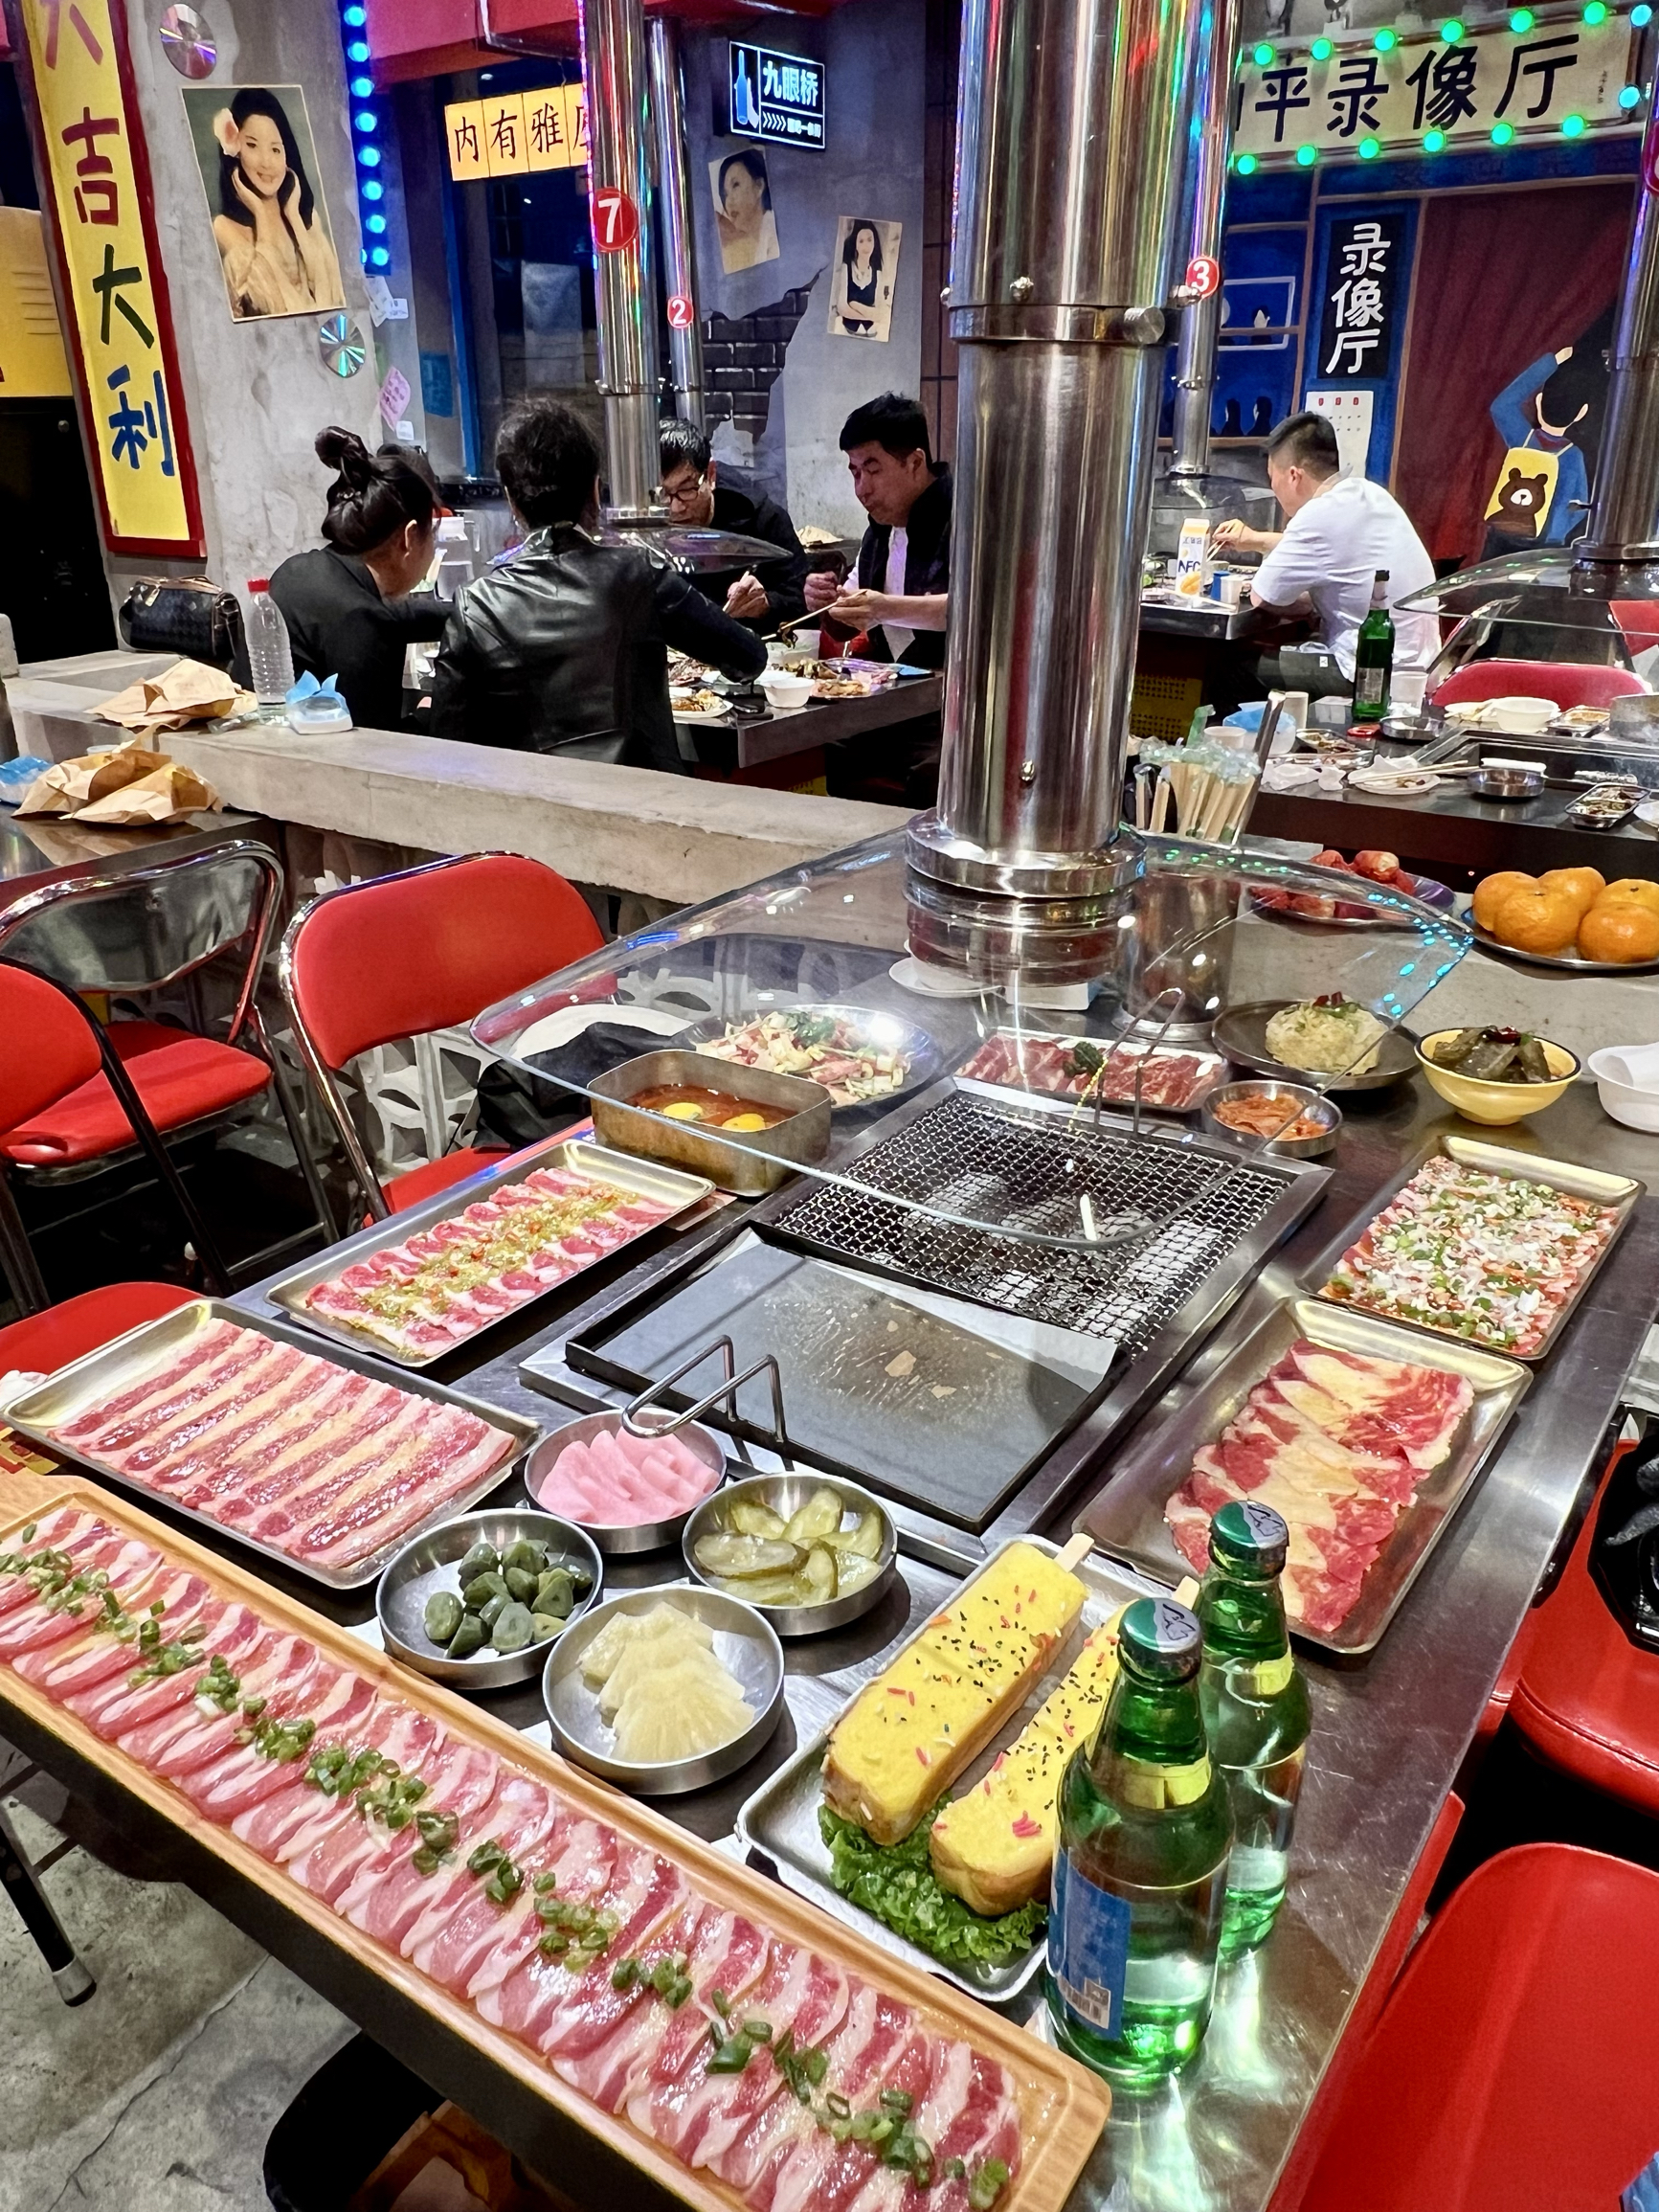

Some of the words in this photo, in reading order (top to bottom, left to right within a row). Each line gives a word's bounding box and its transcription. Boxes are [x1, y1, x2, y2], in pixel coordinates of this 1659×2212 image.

[763, 60, 818, 106] 九眼桥
[1236, 34, 1580, 143] 平录像厅
[597, 197, 620, 243] 7
[1191, 260, 1210, 292] 3
[1326, 222, 1391, 374] 录像厅
[672, 299, 686, 325] 2
[1178, 559, 1200, 574] NFC
